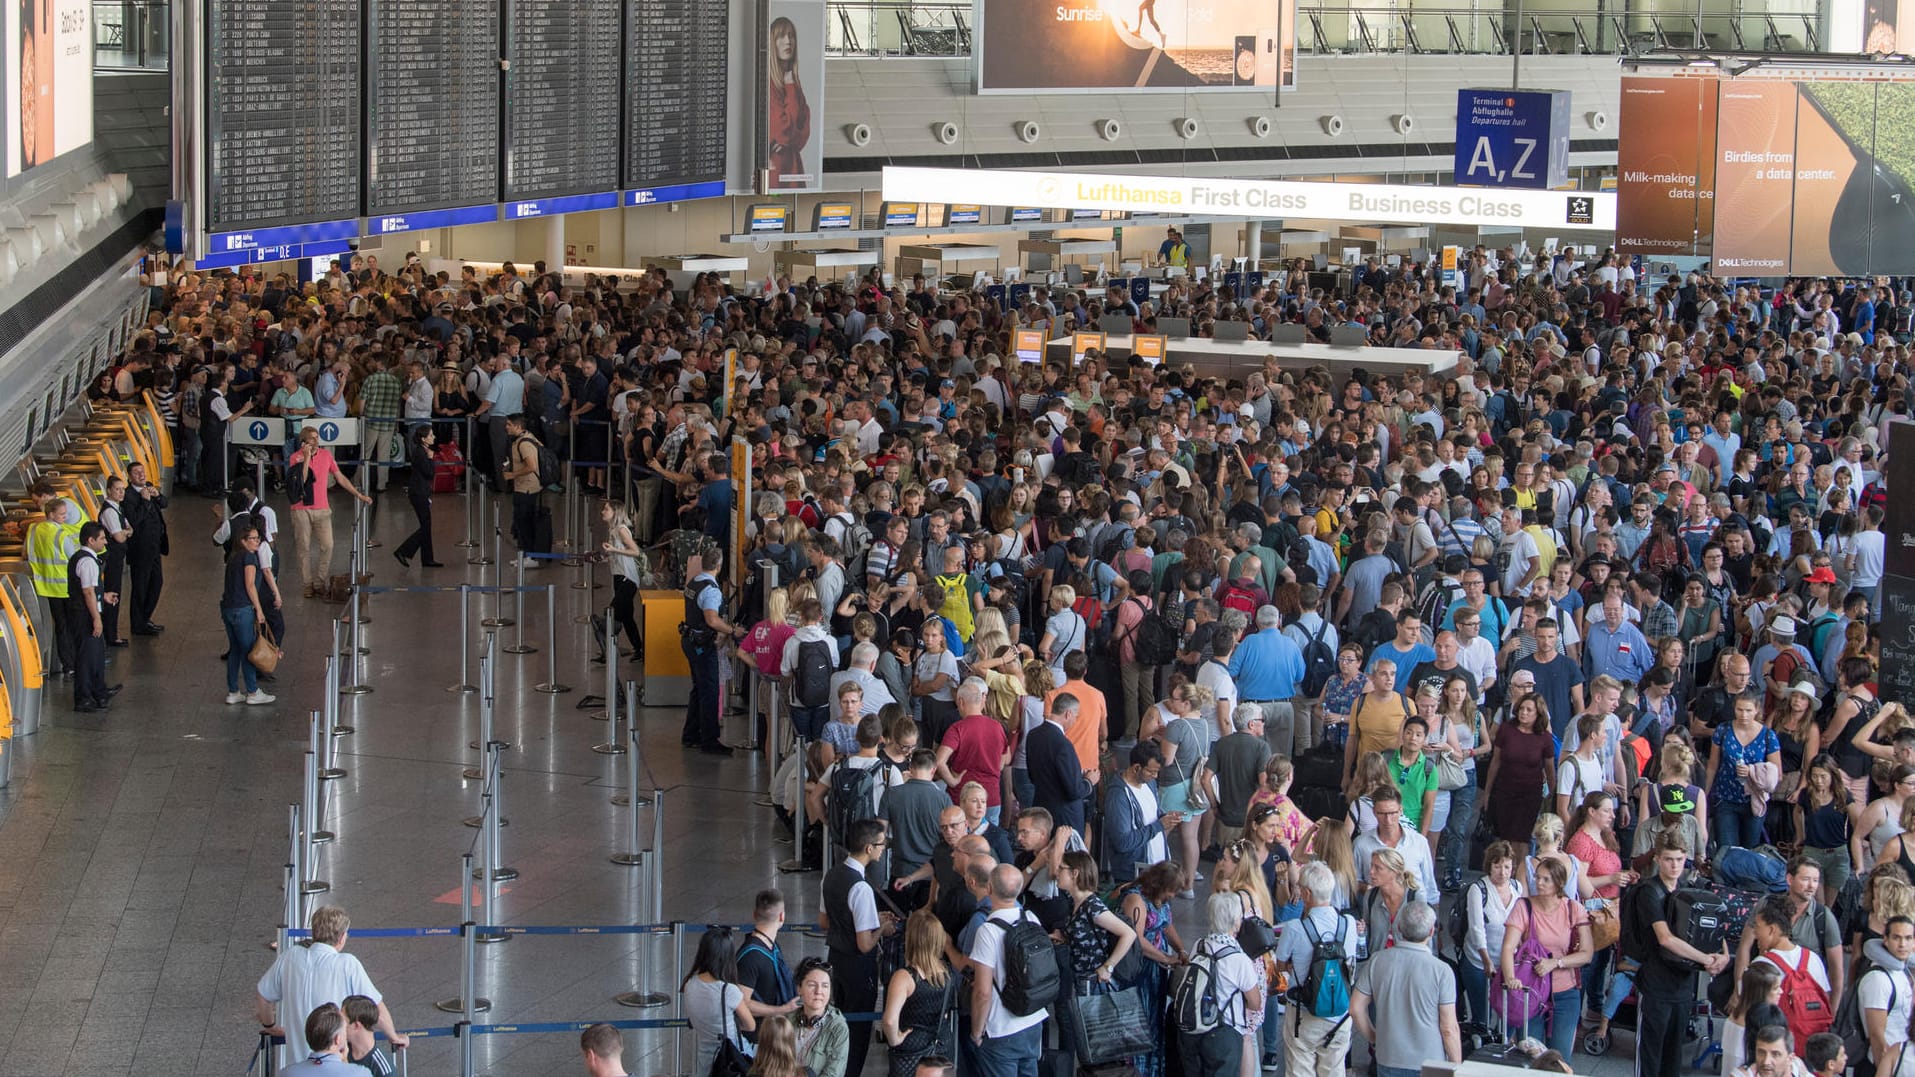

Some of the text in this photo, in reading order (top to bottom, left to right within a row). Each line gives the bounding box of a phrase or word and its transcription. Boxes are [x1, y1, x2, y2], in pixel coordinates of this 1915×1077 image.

[1056, 6, 1103, 22] Sunrise
[1473, 96, 1504, 106] Terminal
[1472, 107, 1514, 117] Abflughalle
[1472, 116, 1526, 127] Departures hall
[1467, 136, 1537, 183] A,Z
[1724, 151, 1792, 163] Birdies from
[1624, 171, 1696, 186] Milk-making
[1756, 168, 1836, 180] a data center.
[1077, 183, 1307, 210] Lufthansa First Class
[1669, 189, 1694, 199] data
[1348, 192, 1523, 218] Business Class
[1621, 238, 1688, 248] DELL Technologies
[280, 245, 290, 258] D,E
[1718, 258, 1784, 268] DELL Technologies
